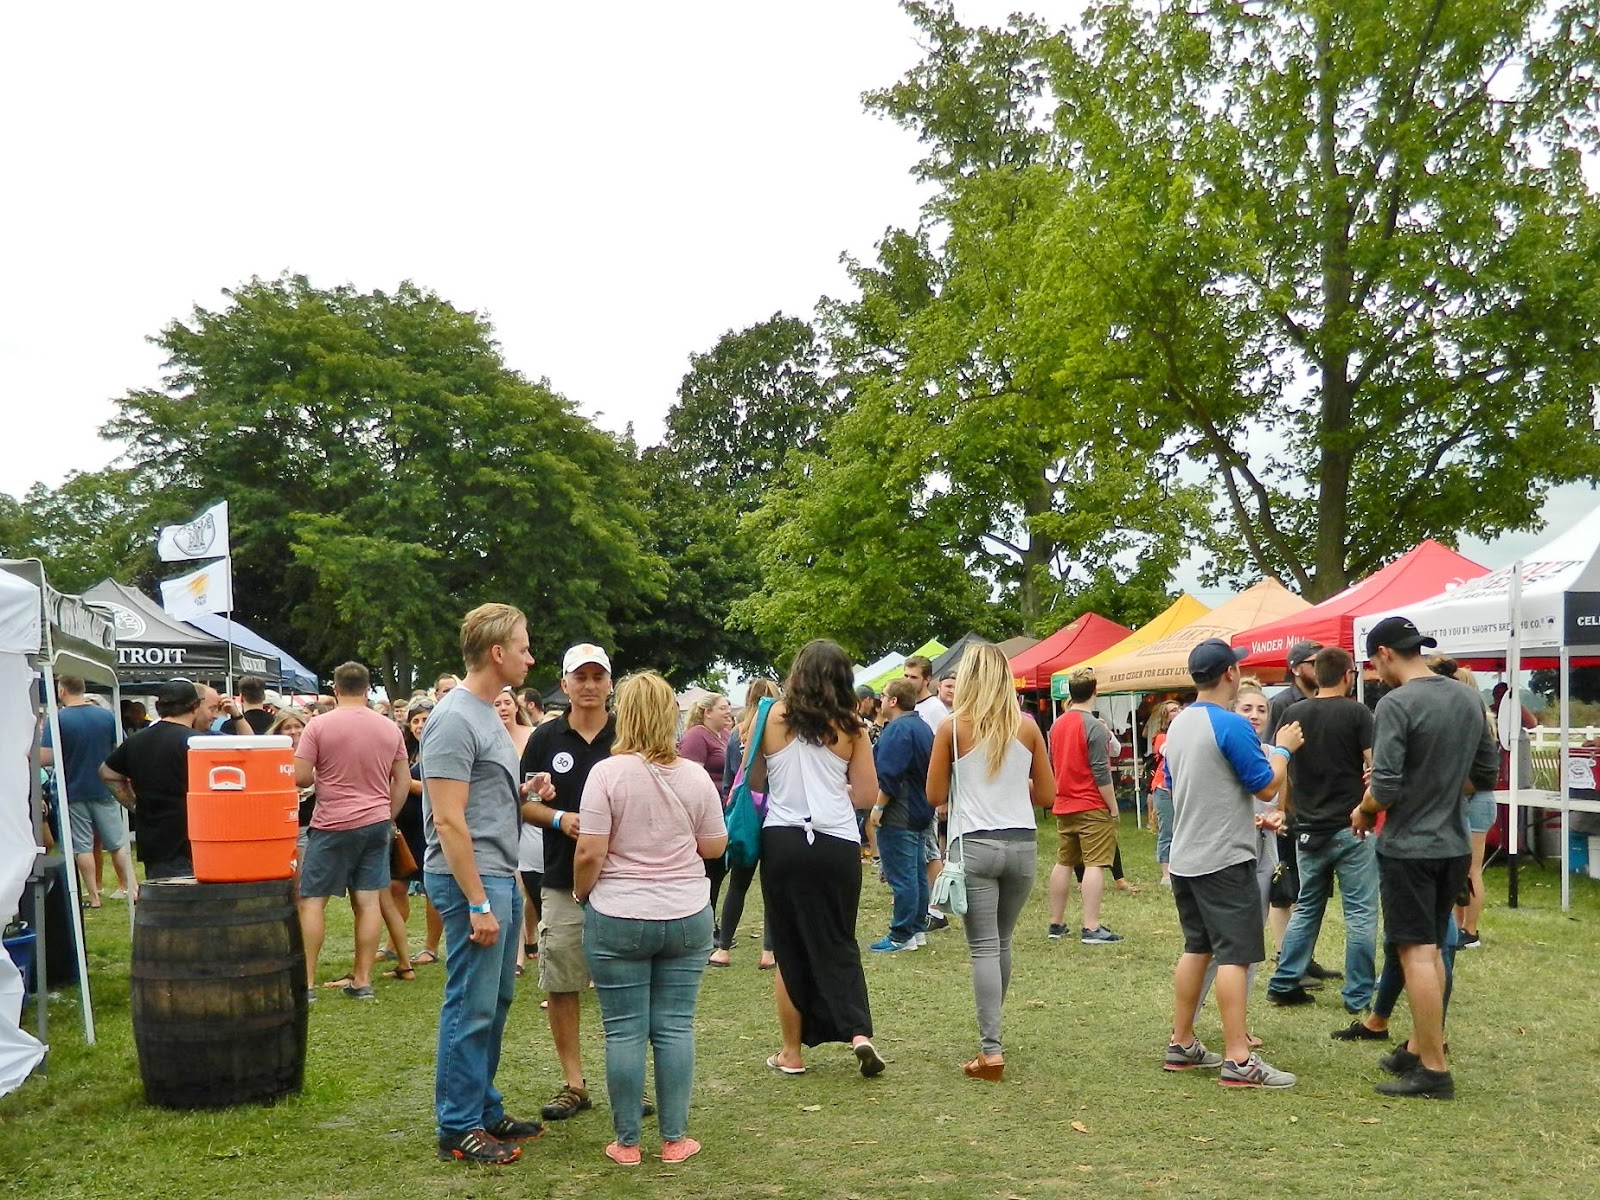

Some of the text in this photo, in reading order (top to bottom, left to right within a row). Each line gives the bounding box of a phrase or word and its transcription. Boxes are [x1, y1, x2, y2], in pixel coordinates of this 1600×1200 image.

[1576, 615, 1600, 627] CEL
[1439, 628, 1447, 637] TO
[1448, 626, 1461, 636] YOU
[1462, 625, 1470, 635] BY
[1471, 623, 1497, 634] SHORT'S
[116, 647, 187, 665] TROIT
[1109, 673, 1126, 683] HARD
[1125, 670, 1143, 680] CIDER
[1143, 669, 1156, 678] FOR
[1156, 667, 1175, 676] EASY
[557, 756, 569, 768] 30
